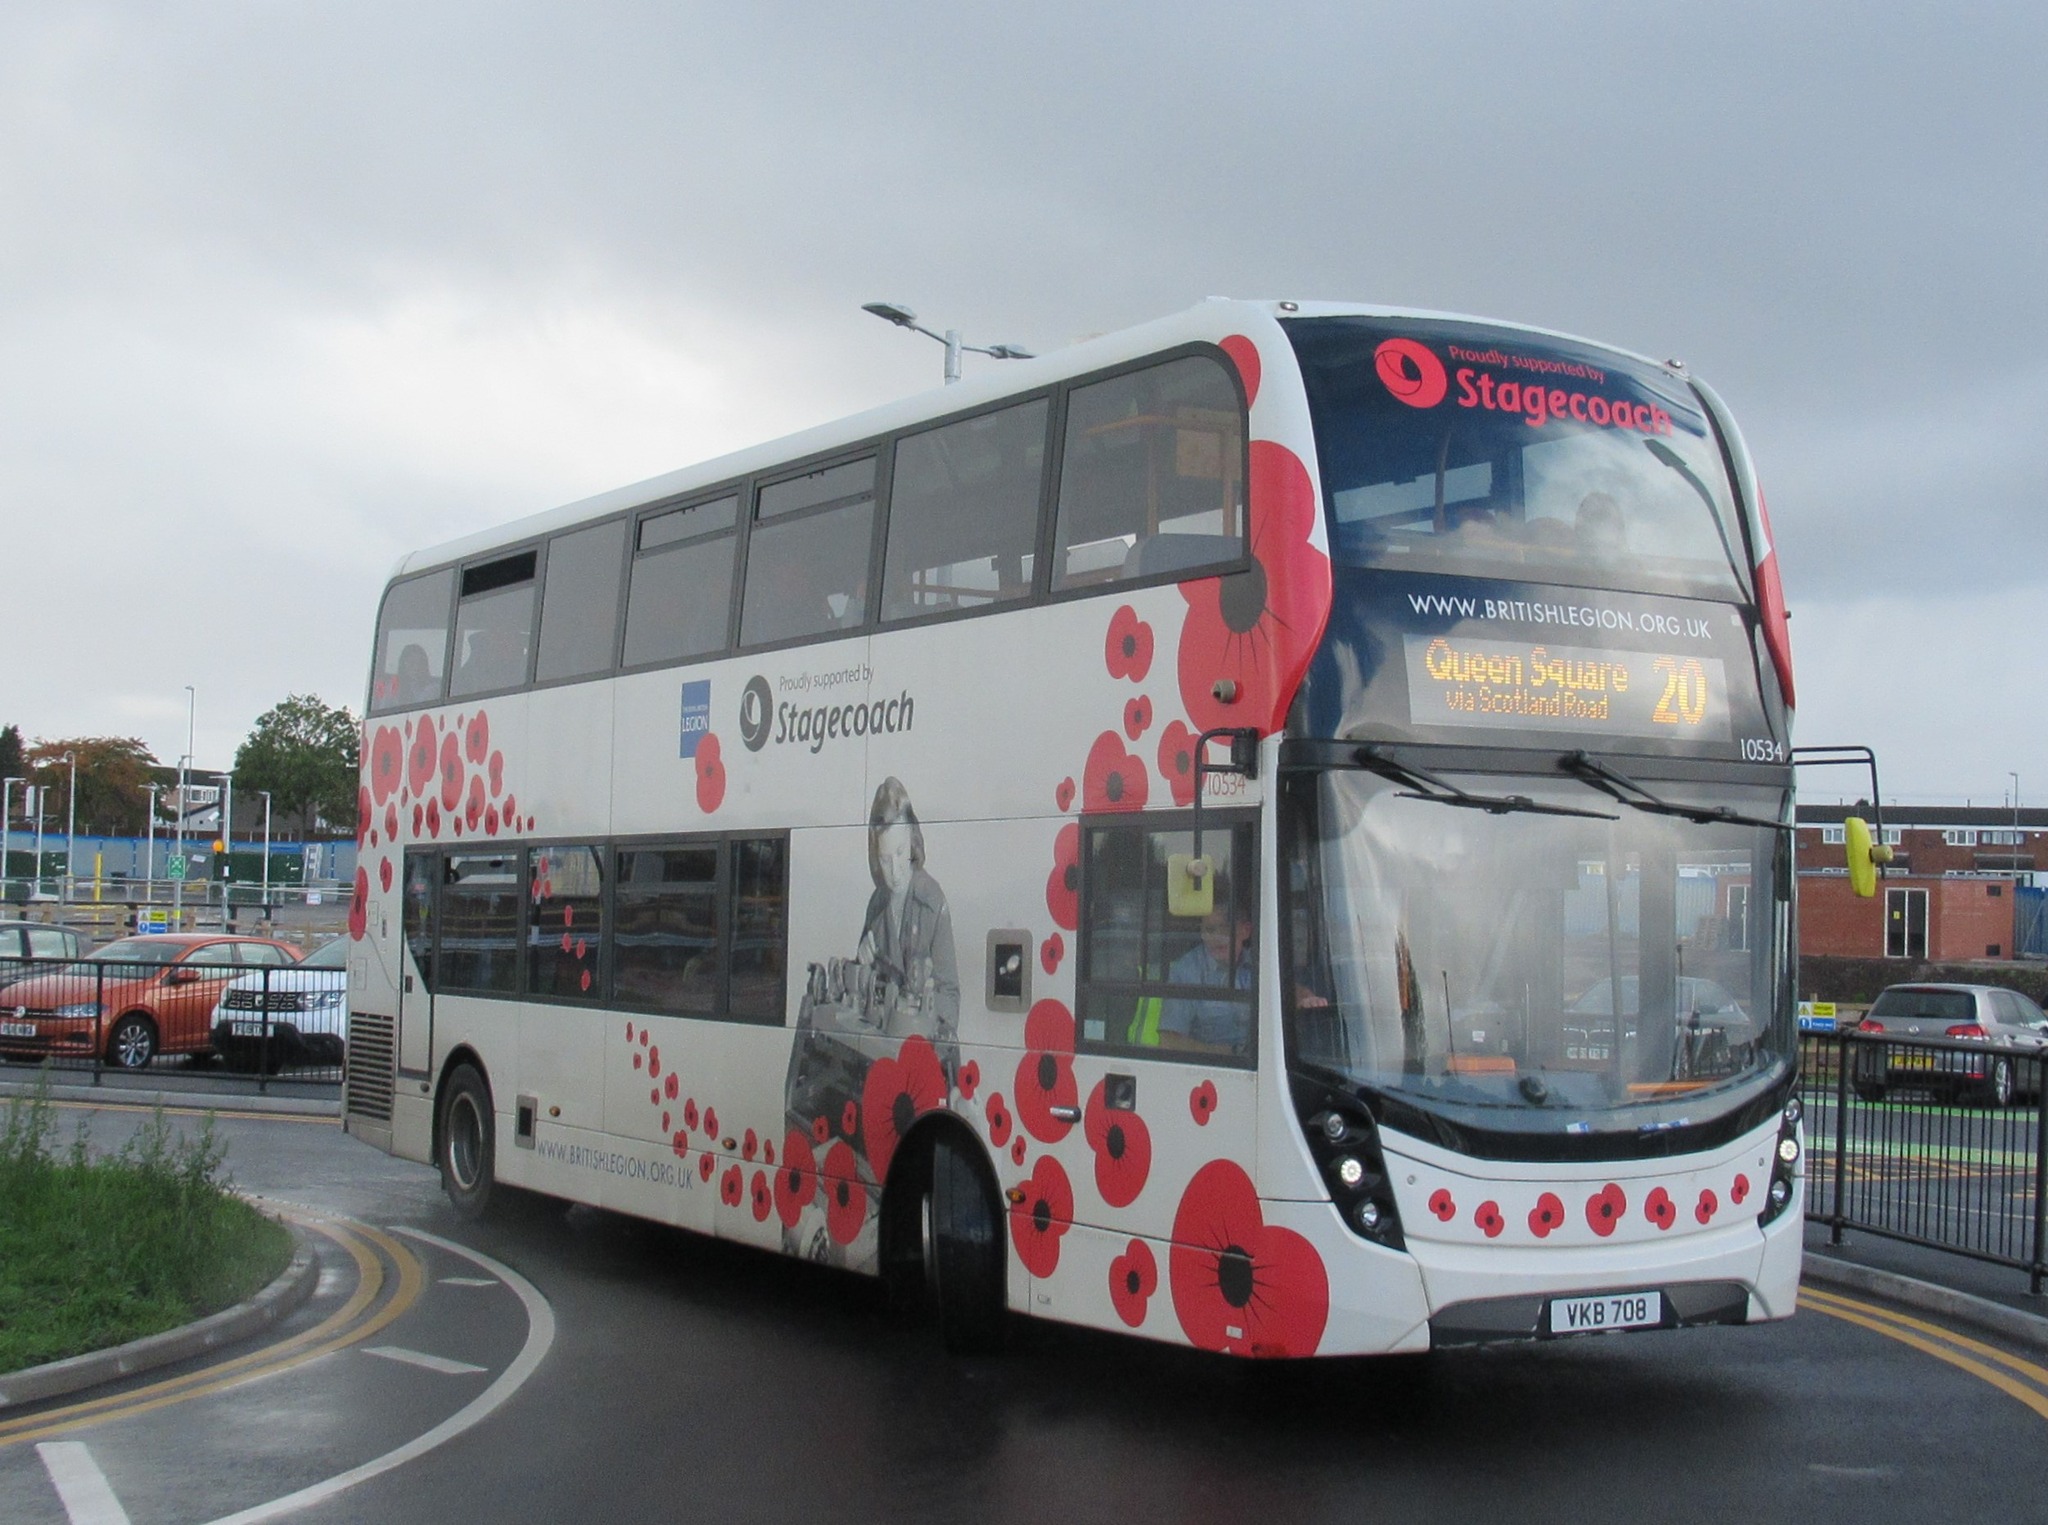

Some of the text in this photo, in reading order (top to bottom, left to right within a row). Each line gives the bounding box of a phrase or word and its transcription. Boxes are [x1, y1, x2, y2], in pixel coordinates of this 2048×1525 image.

[1448, 345, 1606, 385] Proudly supported by
[1456, 367, 1674, 438] Stagecoach
[1407, 593, 1712, 639] WWW.BRITISHLEGION.ORG.UK
[779, 662, 875, 693] Proudly supported by
[1425, 638, 1629, 692] Queen Square
[1446, 686, 1609, 720] via Scotland Road
[1652, 655, 1708, 725] 20
[682, 714, 708, 733] LEGION
[775, 688, 915, 755] Stagecoach
[1740, 738, 1784, 762] 10534
[1208, 772, 1246, 796] 10534
[537, 1138, 693, 1190] WWW.BRITISHLEGION.ORG.UK
[1567, 1298, 1648, 1327] VKB 708
